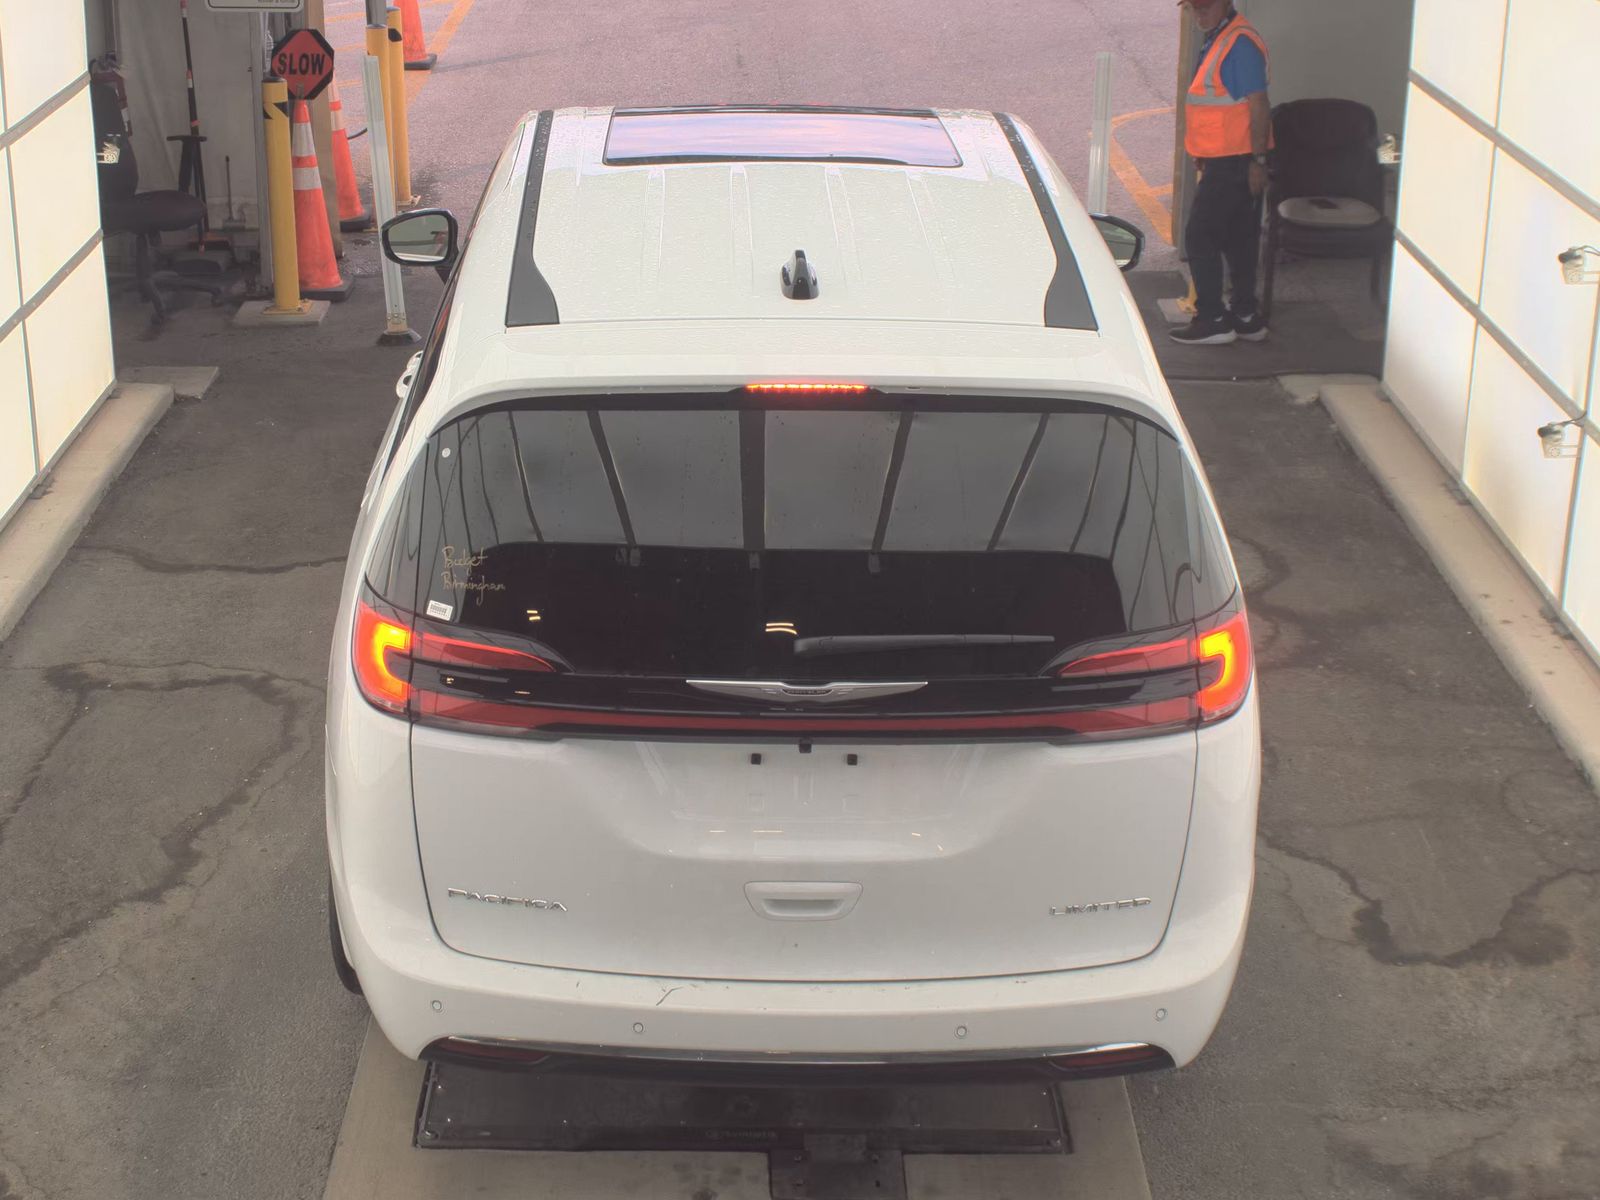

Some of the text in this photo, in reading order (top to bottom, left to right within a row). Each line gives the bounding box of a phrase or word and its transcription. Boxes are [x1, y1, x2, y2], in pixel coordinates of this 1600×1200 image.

[278, 53, 325, 75] SLOW
[442, 545, 488, 576] Budget
[441, 571, 506, 606] Birmingham
[447, 887, 568, 912] PACIFICA
[1050, 897, 1151, 915] LIMITED
